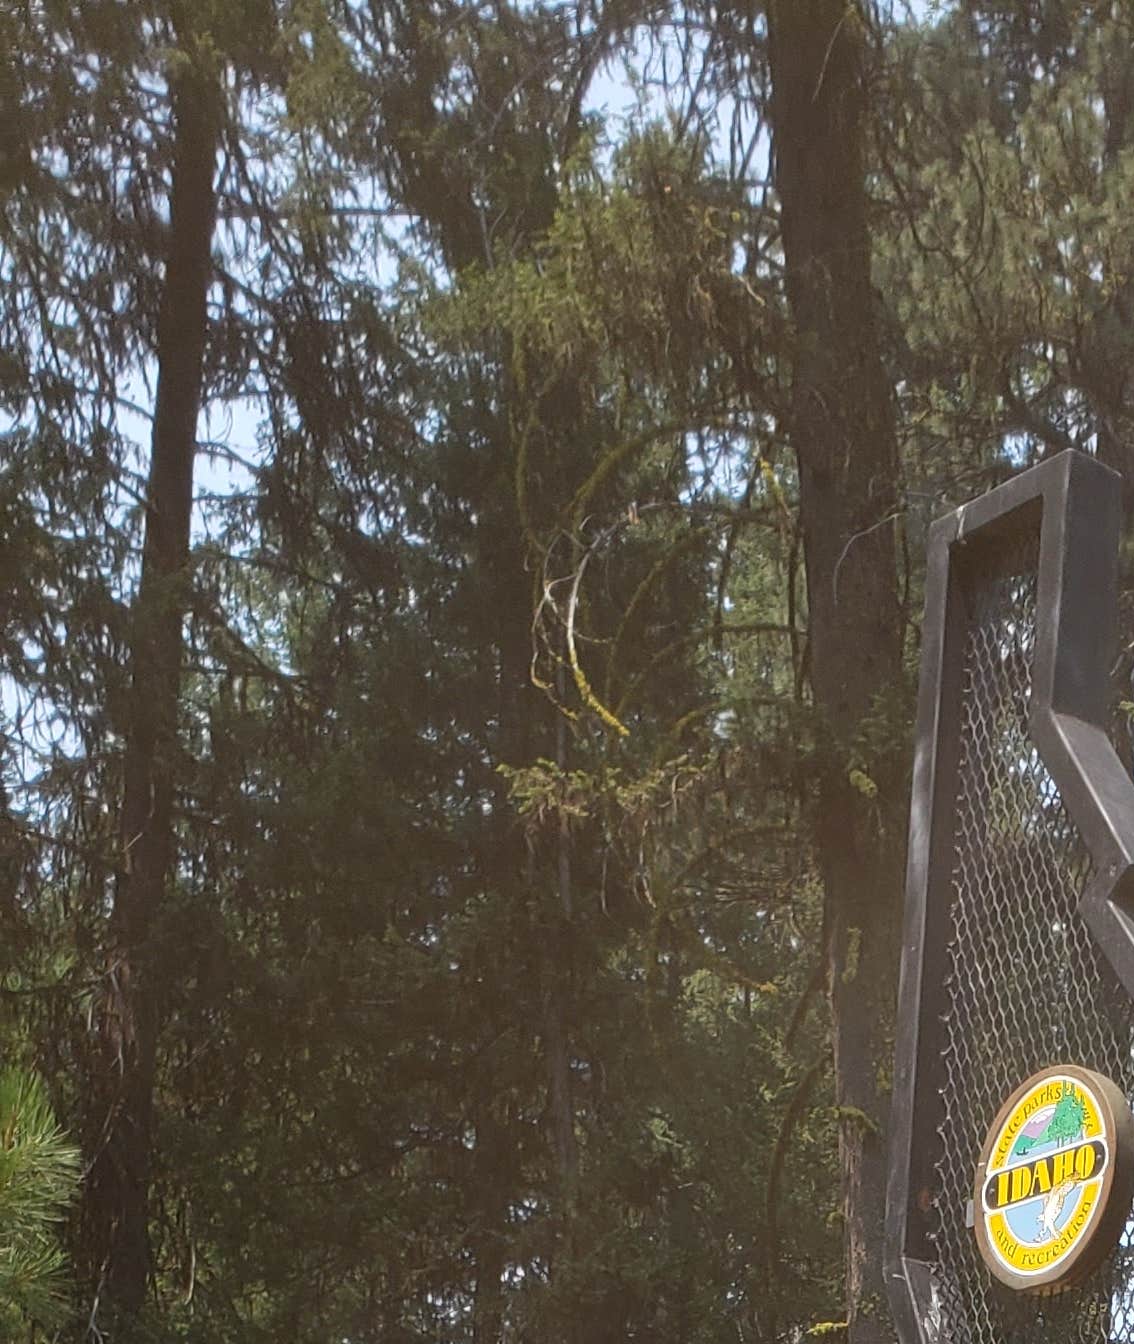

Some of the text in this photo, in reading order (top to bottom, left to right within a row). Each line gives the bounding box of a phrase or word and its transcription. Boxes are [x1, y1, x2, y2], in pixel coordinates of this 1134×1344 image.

[996, 1085, 1062, 1167] state parks
[996, 1144, 1096, 1207] IDAHO
[996, 1201, 1091, 1265] and recreation
